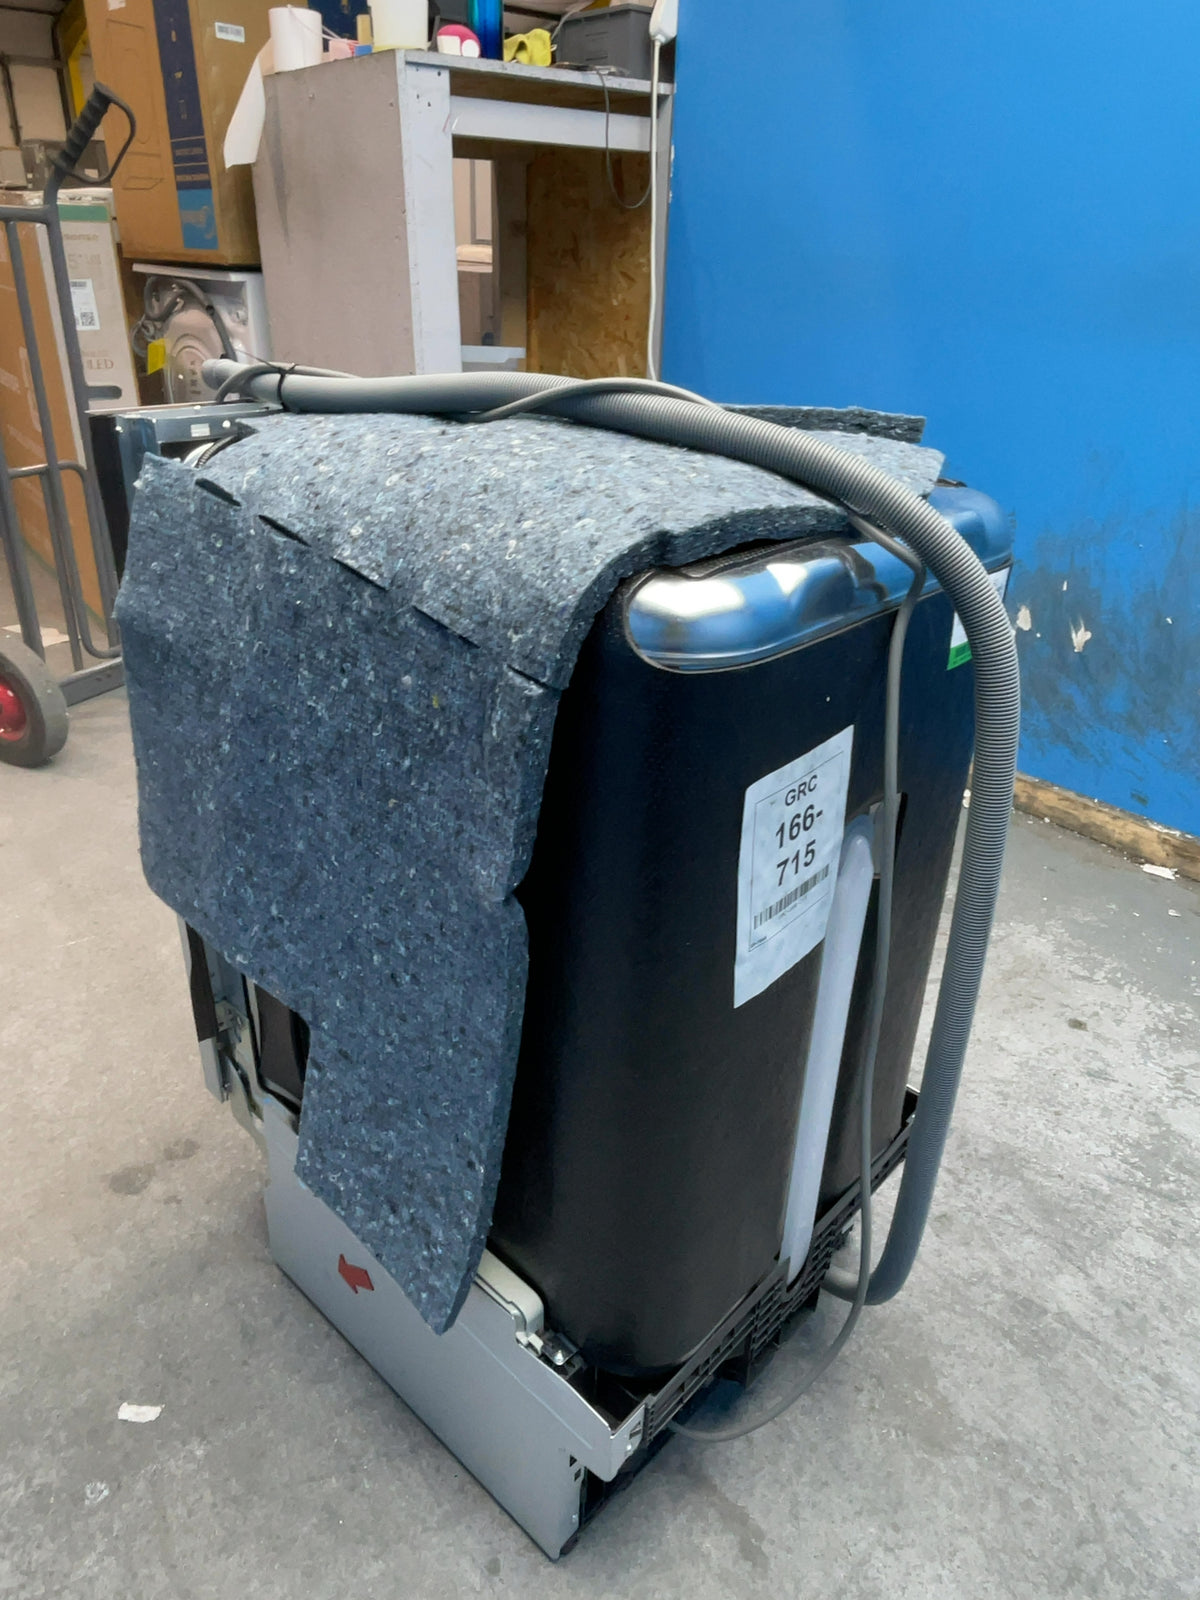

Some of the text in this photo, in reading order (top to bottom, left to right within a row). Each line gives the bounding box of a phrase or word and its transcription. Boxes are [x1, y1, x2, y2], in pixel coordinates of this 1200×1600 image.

[785, 774, 818, 807] GRC
[775, 804, 824, 849] 166-
[776, 839, 817, 887] 715
